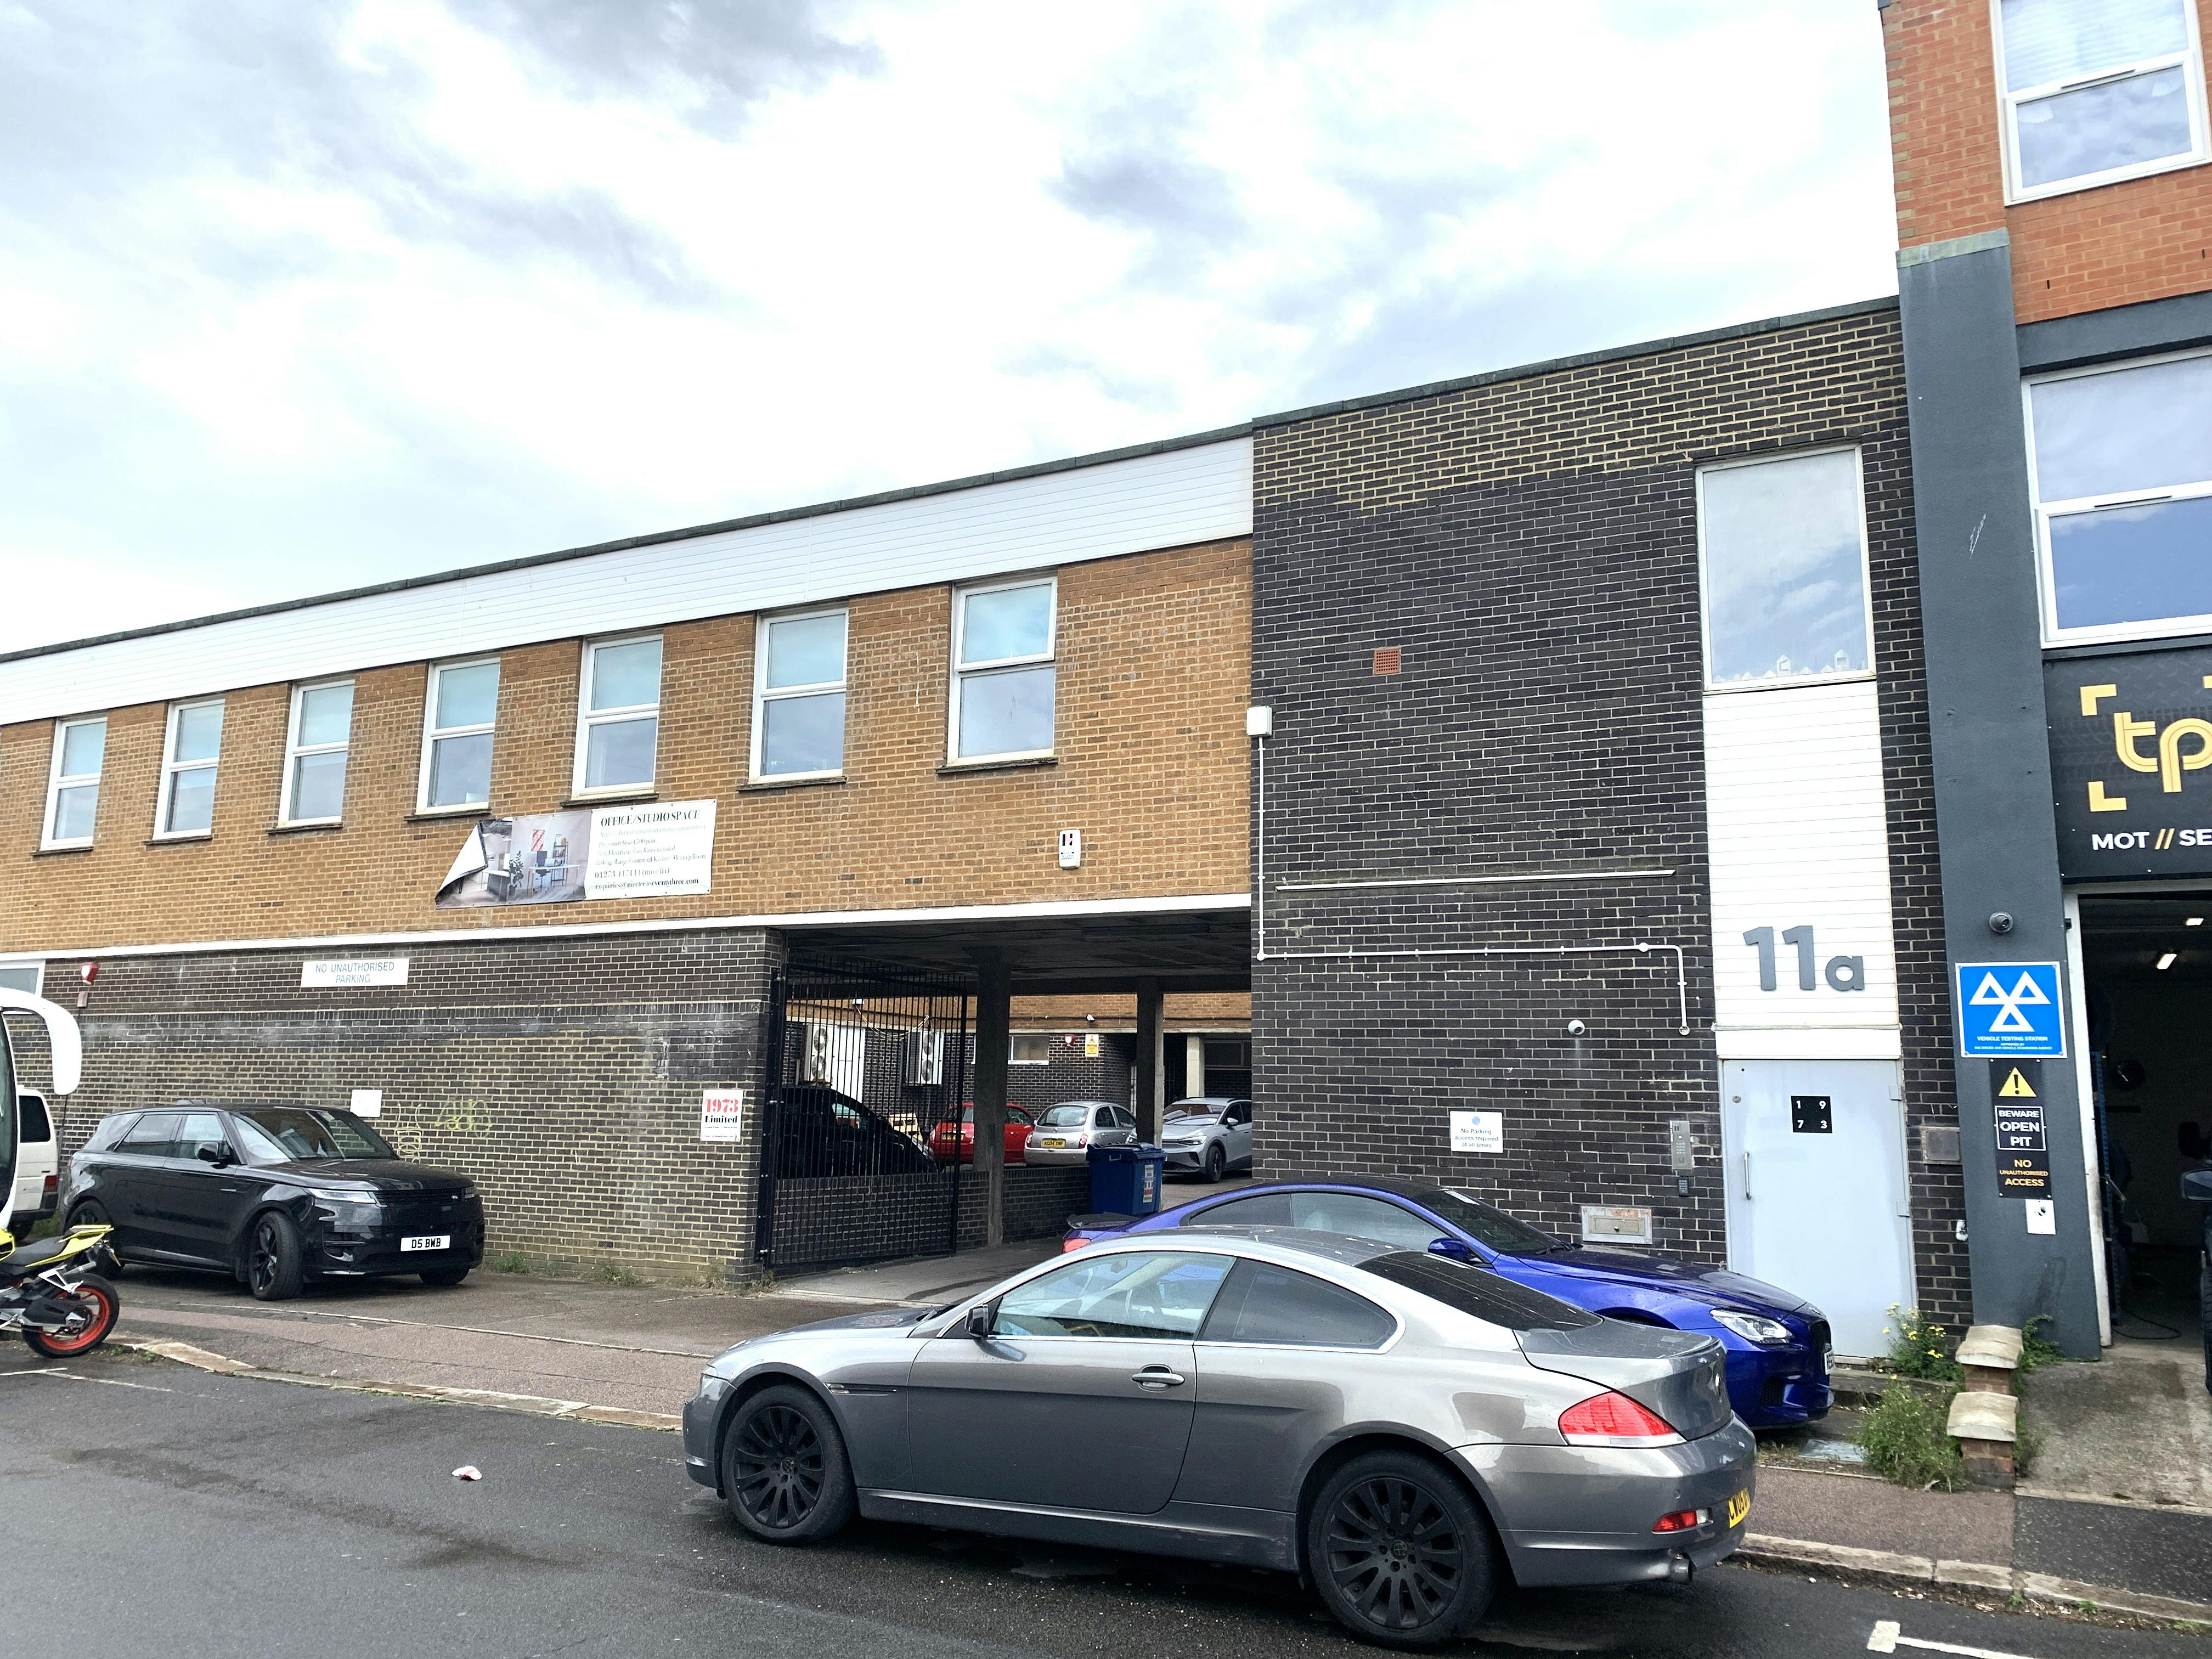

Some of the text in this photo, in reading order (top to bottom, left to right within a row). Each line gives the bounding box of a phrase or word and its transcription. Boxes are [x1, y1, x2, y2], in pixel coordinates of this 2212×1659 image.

[2092, 832, 2150, 850] MOT
[2179, 828, 2212, 847] SE
[595, 870, 616, 878] 01273
[1743, 925, 1865, 991] 11a
[315, 962, 394, 973] NO UNAUTHORISED
[336, 974, 370, 984] PARKING
[704, 1098, 738, 1113] 1973
[1999, 1110, 2040, 1118] BEWARE
[2000, 1121, 2040, 1132] OPEN
[2010, 1136, 2033, 1147] PIT
[2014, 1159, 2032, 1168] NO
[2005, 1178, 2045, 1186] ACCESS
[411, 1238, 441, 1249] D5 BWB
